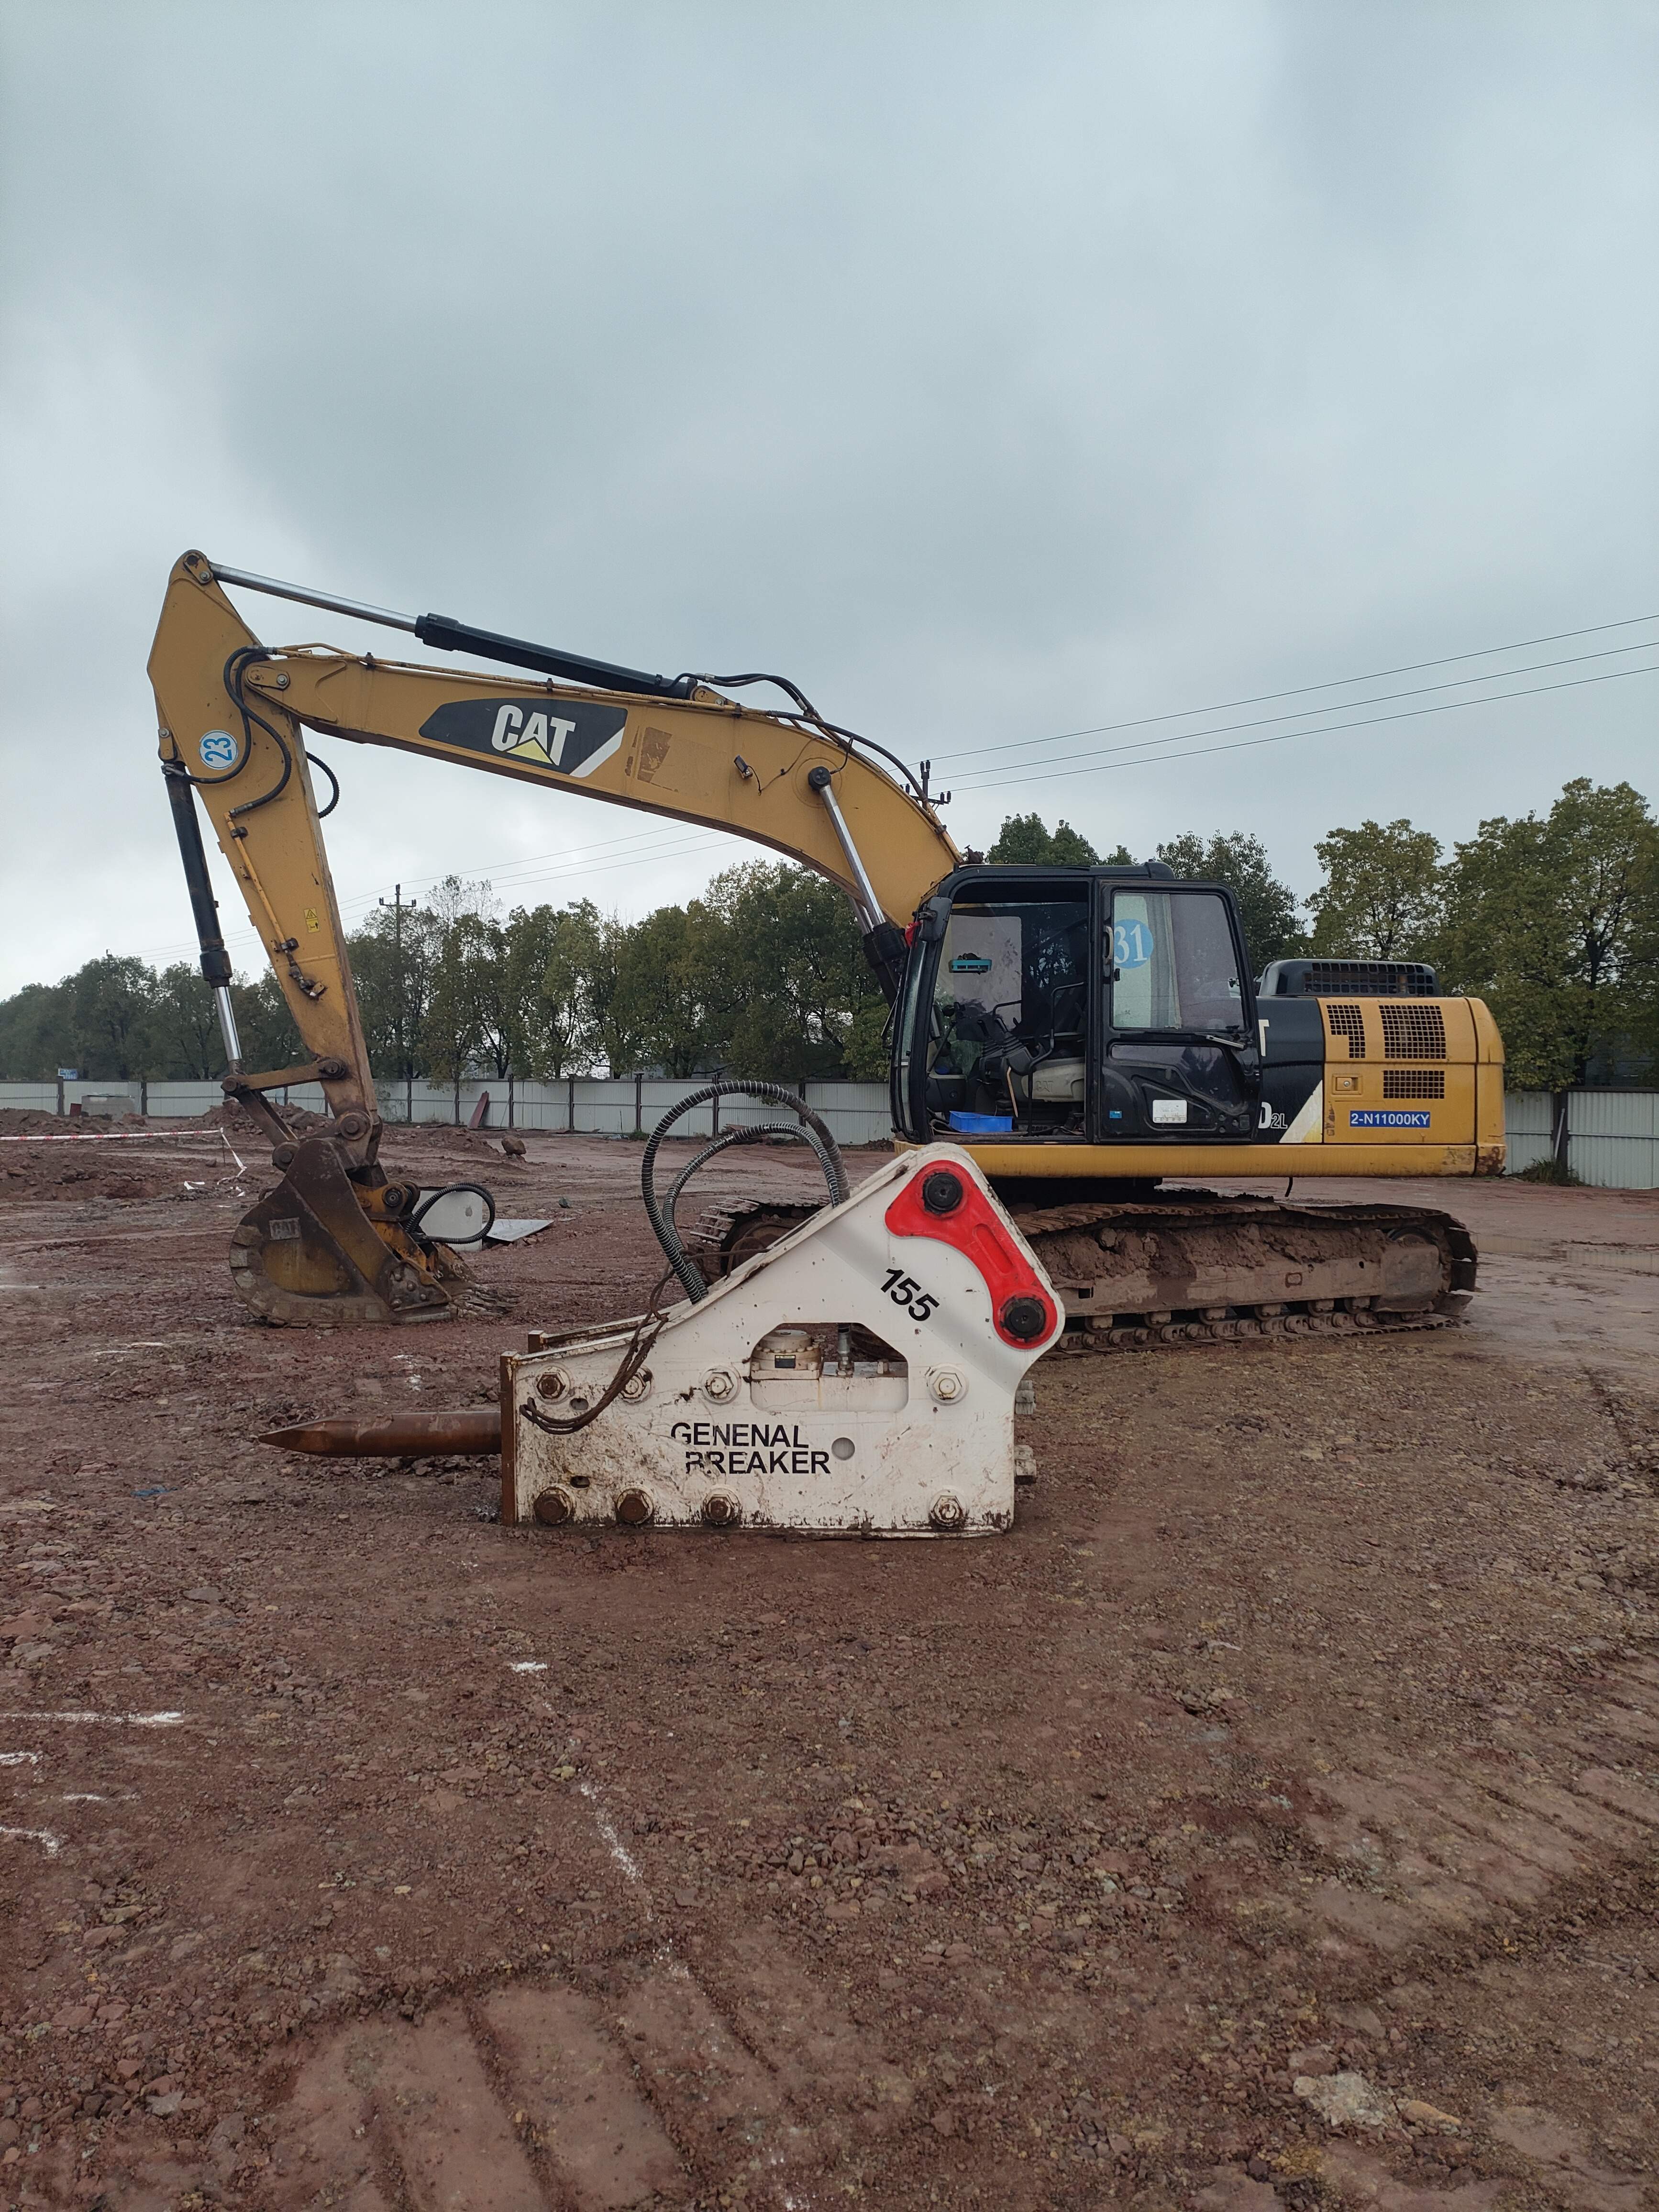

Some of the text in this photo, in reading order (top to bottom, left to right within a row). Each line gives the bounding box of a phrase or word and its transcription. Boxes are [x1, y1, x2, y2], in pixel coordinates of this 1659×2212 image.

[203, 738, 232, 762] 23
[492, 705, 575, 765] CAT
[1114, 924, 1147, 963] 31
[1350, 1113, 1429, 1125] 2-N11000KY
[881, 1268, 940, 1321] 155
[671, 1422, 809, 1448] GENENAL
